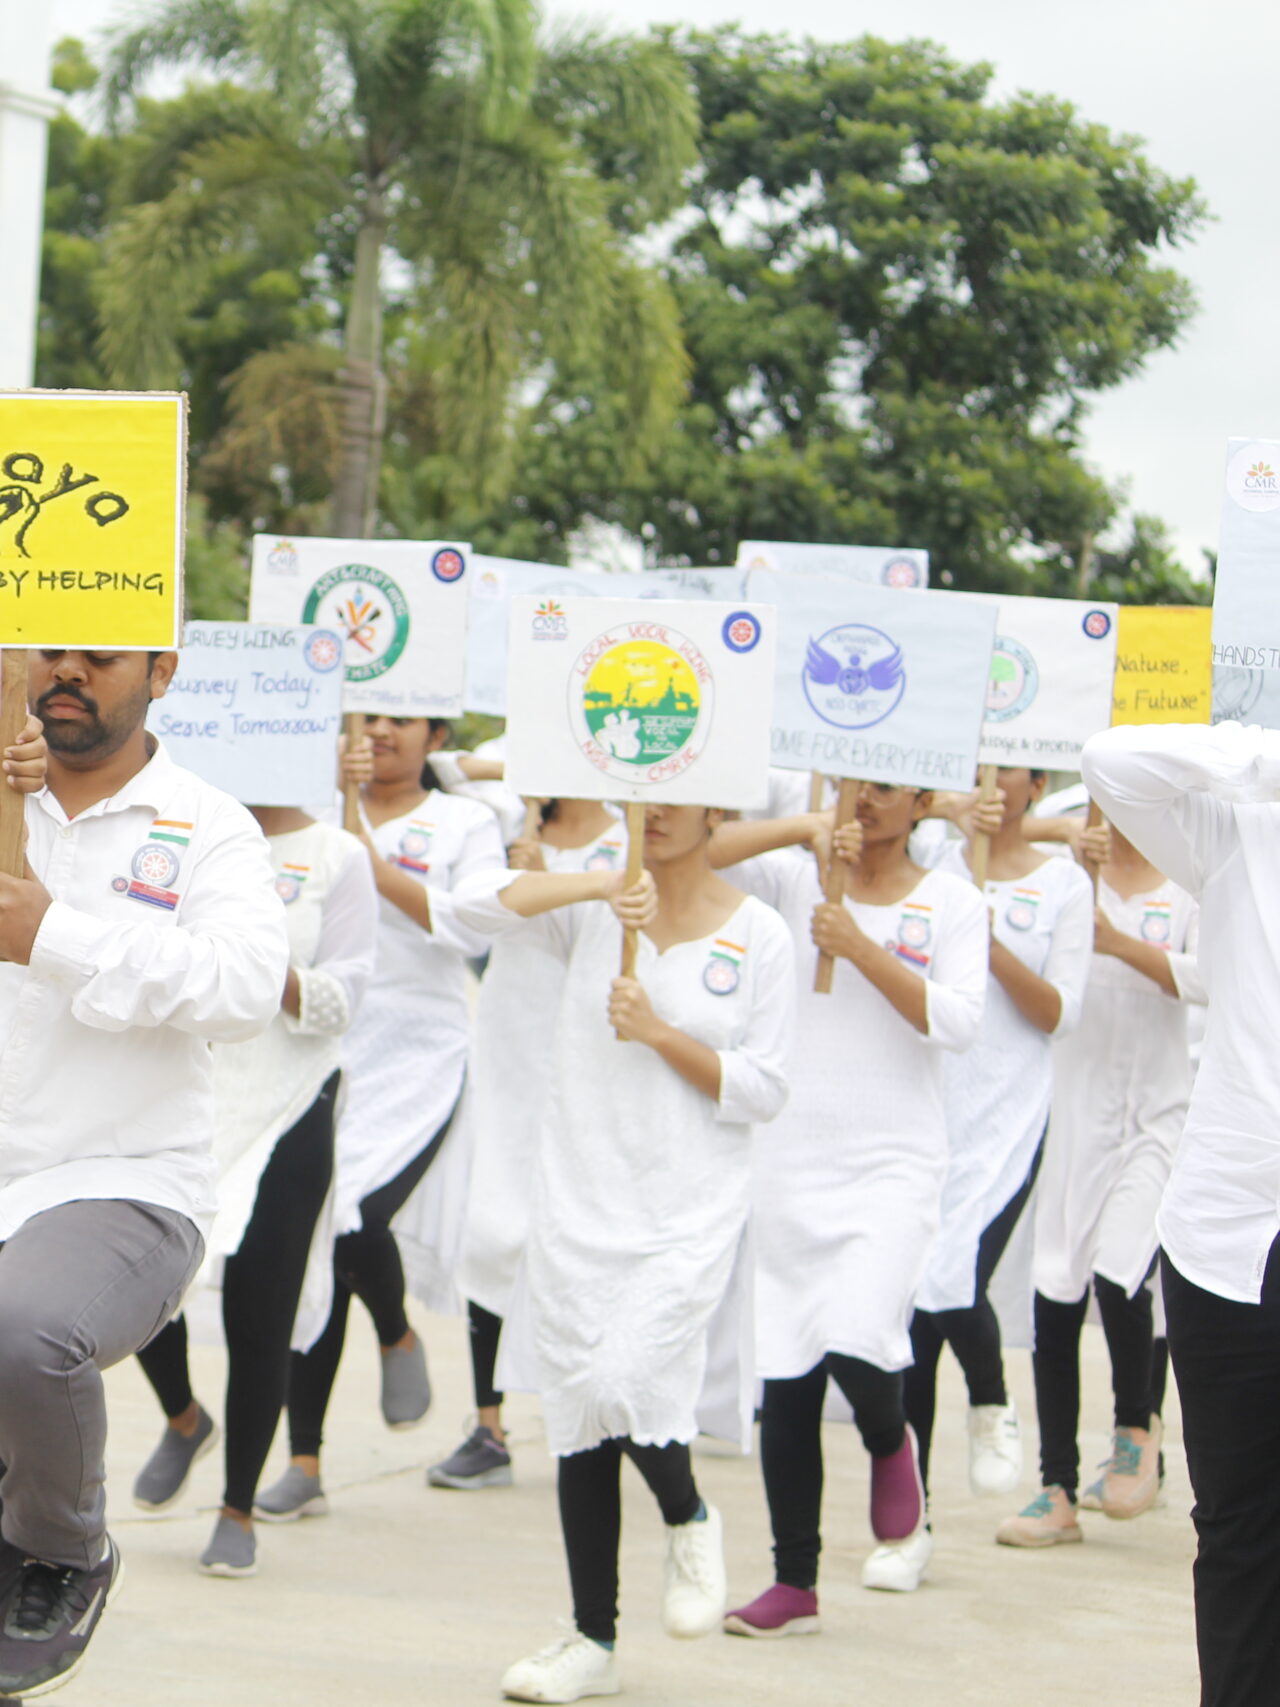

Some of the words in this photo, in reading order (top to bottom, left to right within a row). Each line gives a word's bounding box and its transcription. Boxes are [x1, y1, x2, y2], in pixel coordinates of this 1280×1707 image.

[1244, 477, 1278, 489] CMR
[37, 570, 164, 596] HELPING
[185, 629, 238, 650] URVEY
[244, 630, 296, 649] WING
[576, 635, 619, 677] LOCAL
[628, 624, 669, 643] VOCAL
[1213, 644, 1266, 667] HANDS
[810, 731, 848, 762] FOR
[914, 748, 968, 781] HEART
